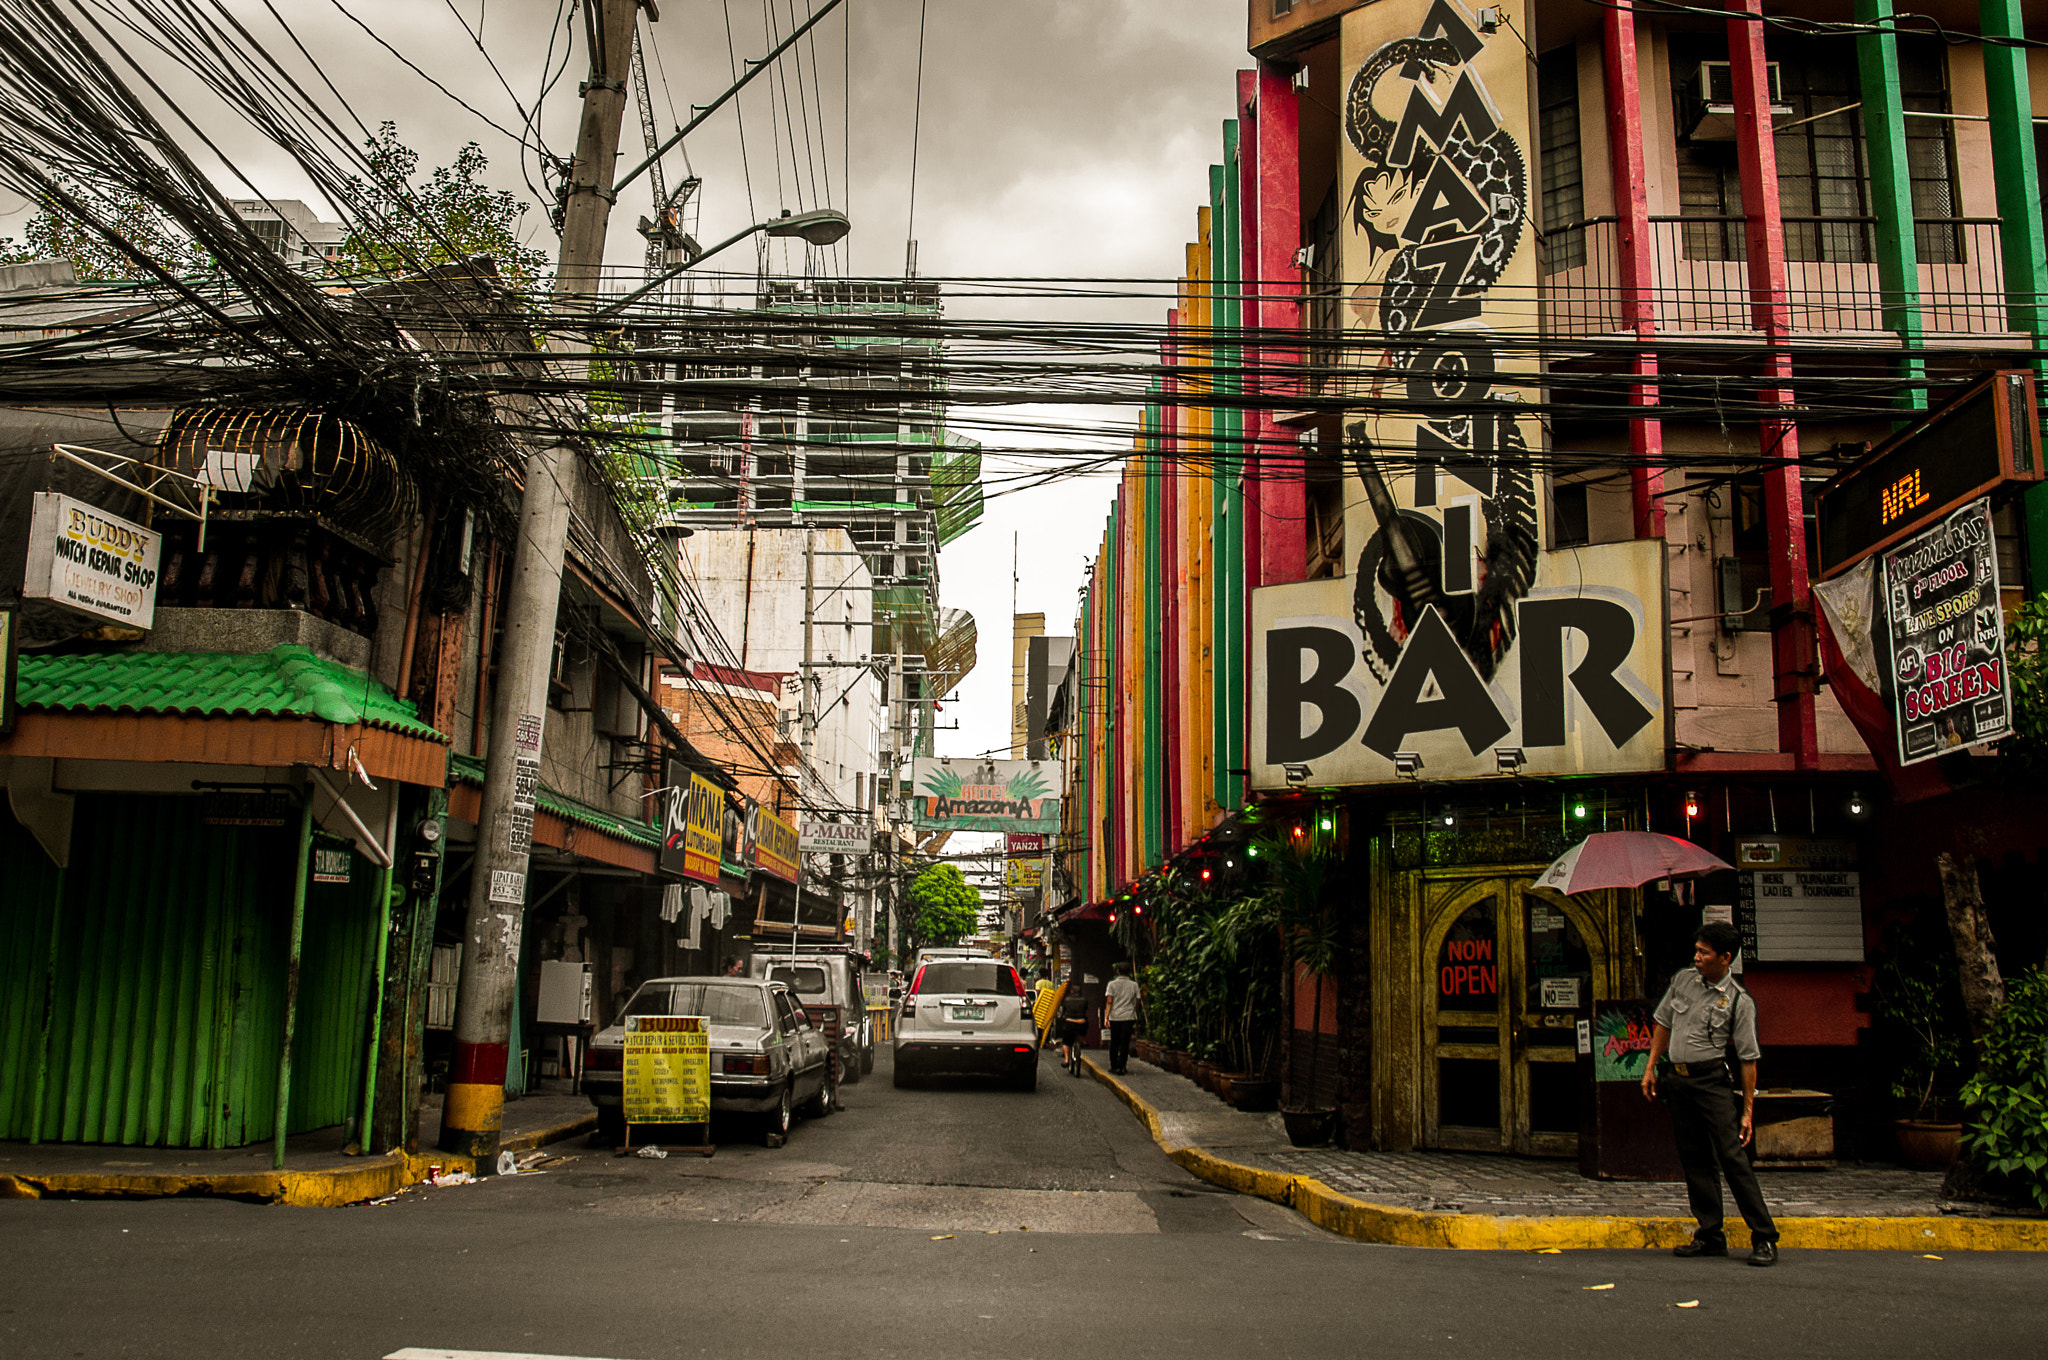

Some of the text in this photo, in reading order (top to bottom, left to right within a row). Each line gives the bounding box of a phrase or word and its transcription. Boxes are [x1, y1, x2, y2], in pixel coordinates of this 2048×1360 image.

[1882, 468, 1930, 525] NRL
[67, 507, 149, 563] BUDDY
[56, 535, 155, 590] WATCH REPAIR SHOP
[1928, 561, 1968, 593] FLOOR
[68, 590, 77, 600] ALL
[96, 600, 132, 616] GUARANTEED
[1905, 610, 1936, 635] LIVE
[1936, 587, 1980, 623] SPORTS
[1938, 625, 1954, 645] ON
[1899, 654, 1919, 675] AFL
[1924, 643, 1968, 685] BIG
[1266, 597, 1654, 765] BAR
[1906, 658, 2001, 721] SCREEN
[961, 785, 1007, 801] HOTEL
[666, 786, 688, 839] RC
[689, 781, 721, 836] MONA
[745, 805, 758, 845] RC
[813, 838, 855, 847] RESTAURANT
[1011, 842, 1039, 851] YAN2X
[1738, 873, 1849, 885] MON MENS TOURNAMENT
[1740, 886, 1855, 897] TUE LADIES TOURNAMENT
[1740, 899, 1754, 909] WED
[1741, 912, 1754, 921] THU
[1448, 939, 1492, 962] NOW
[1540, 941, 1563, 963] 24
[1743, 936, 1755, 946] SAT
[1743, 949, 1757, 959] SUN
[1441, 965, 1497, 995] OPEN
[1545, 990, 1556, 1004] NO
[640, 1018, 699, 1032] BUDDY
[645, 1035, 663, 1046] REPAIR
[688, 1035, 708, 1046] CENTER
